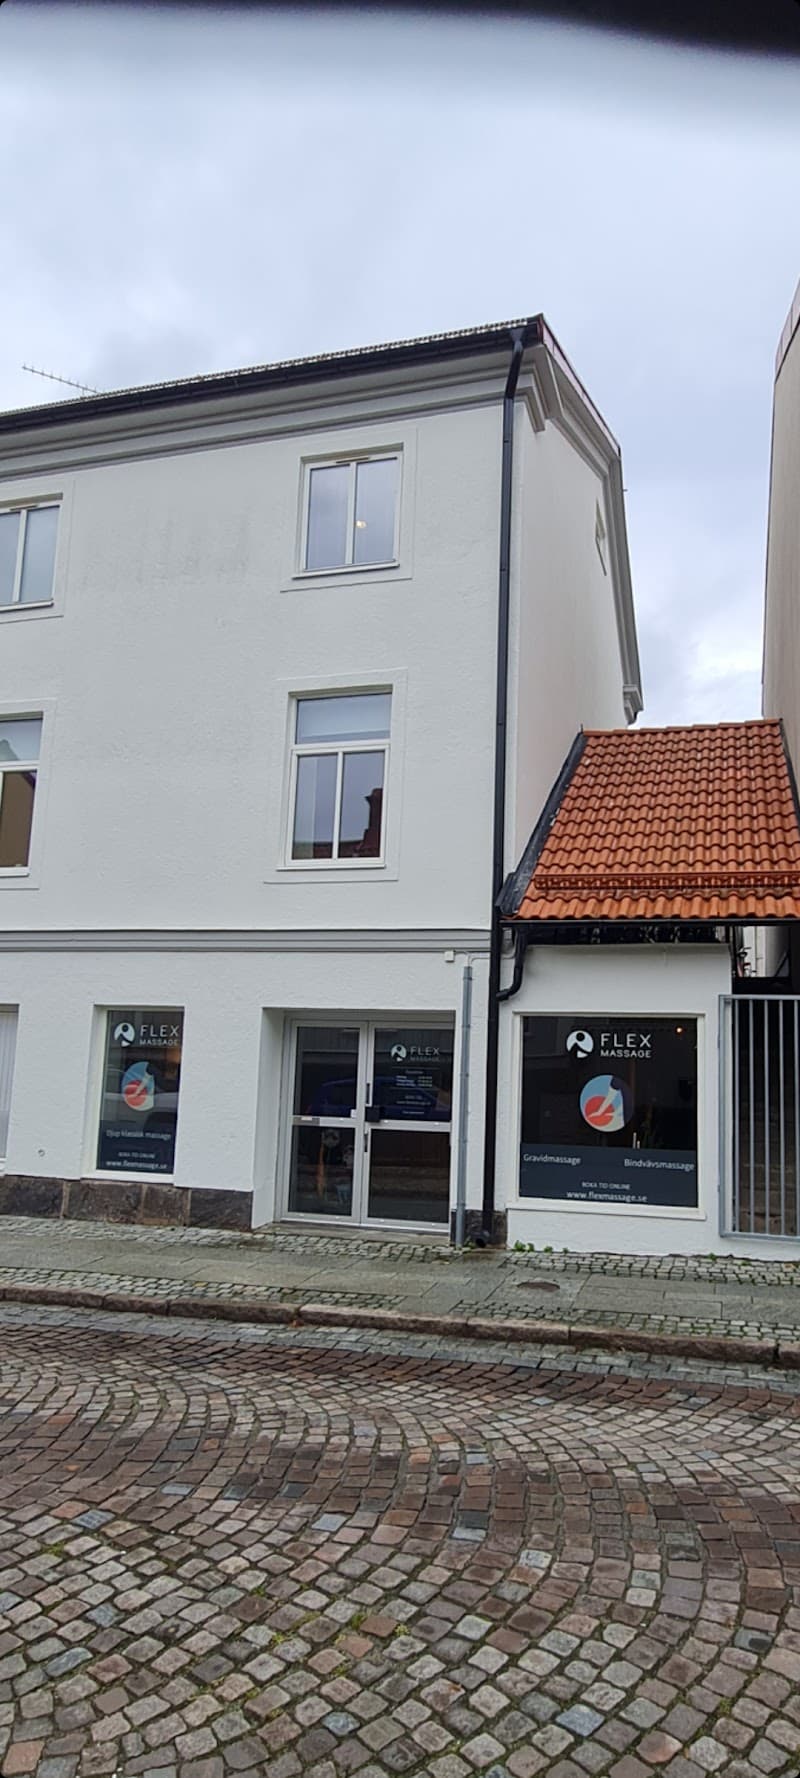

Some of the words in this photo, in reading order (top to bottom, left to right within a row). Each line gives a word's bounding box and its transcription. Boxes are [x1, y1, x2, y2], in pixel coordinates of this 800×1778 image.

[140, 1024, 180, 1038] FLEX
[139, 1039, 178, 1047] MASSAGE
[600, 1032, 652, 1048] FLEX
[410, 1047, 440, 1056] FLEX
[600, 1049, 652, 1058] MASSAGE
[523, 1153, 581, 1166] Gravidmassage
[624, 1158, 695, 1172] Bindvävsmassage
[582, 1181, 598, 1189] BOKA
[567, 1191, 647, 1203] www.flexmassage.se
